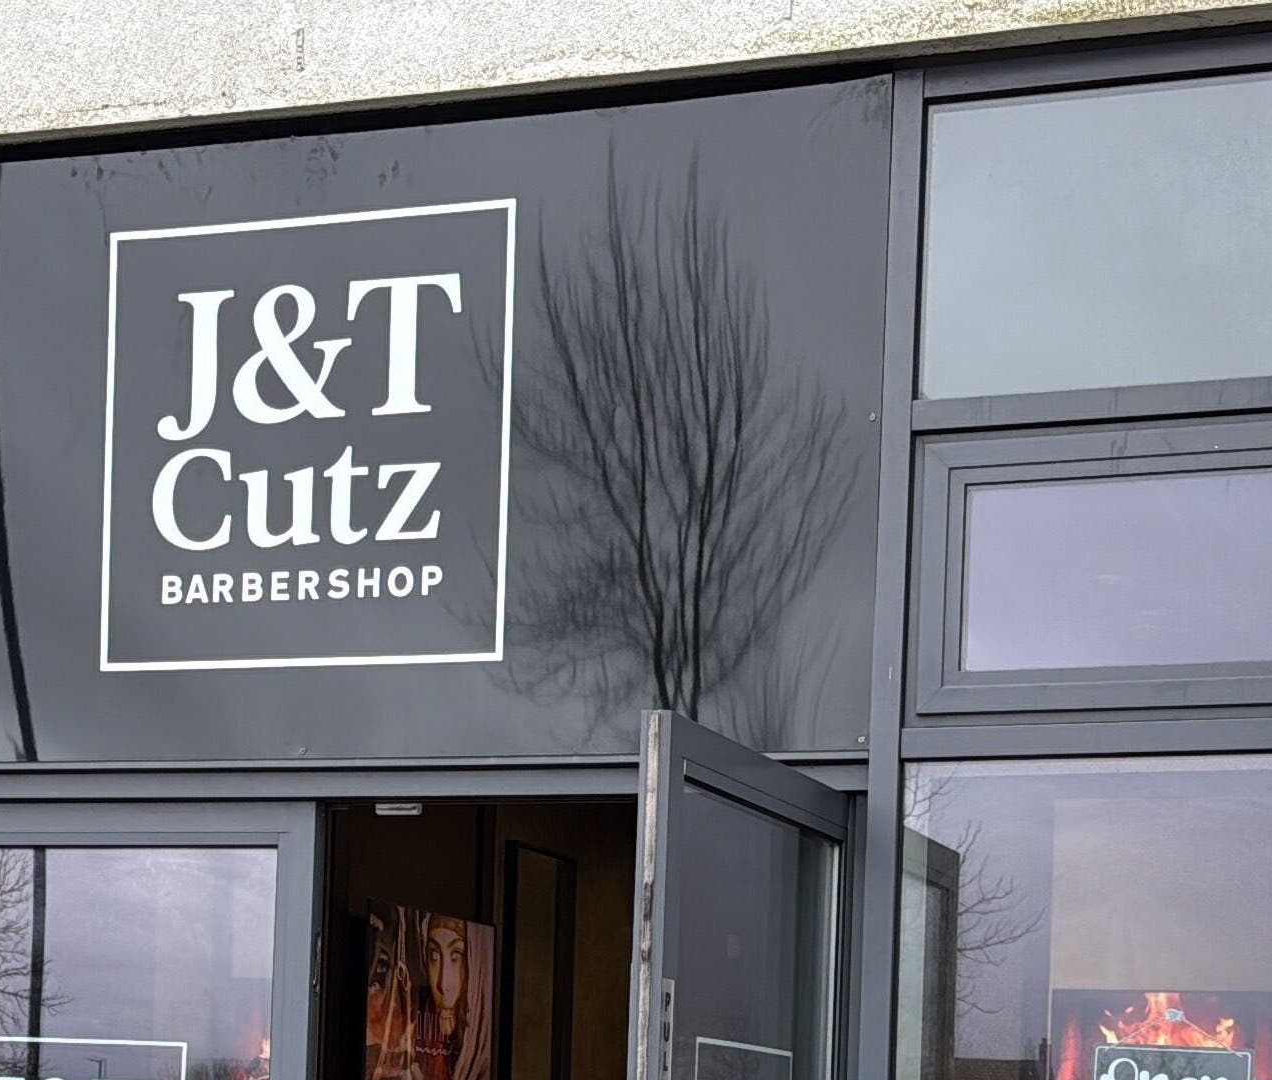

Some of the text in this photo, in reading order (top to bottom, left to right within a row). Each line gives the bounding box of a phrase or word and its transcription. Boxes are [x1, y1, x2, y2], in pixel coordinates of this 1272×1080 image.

[157, 273, 463, 442] J&T
[151, 444, 442, 551] Cutz
[160, 565, 445, 605] BARBERSHOP
